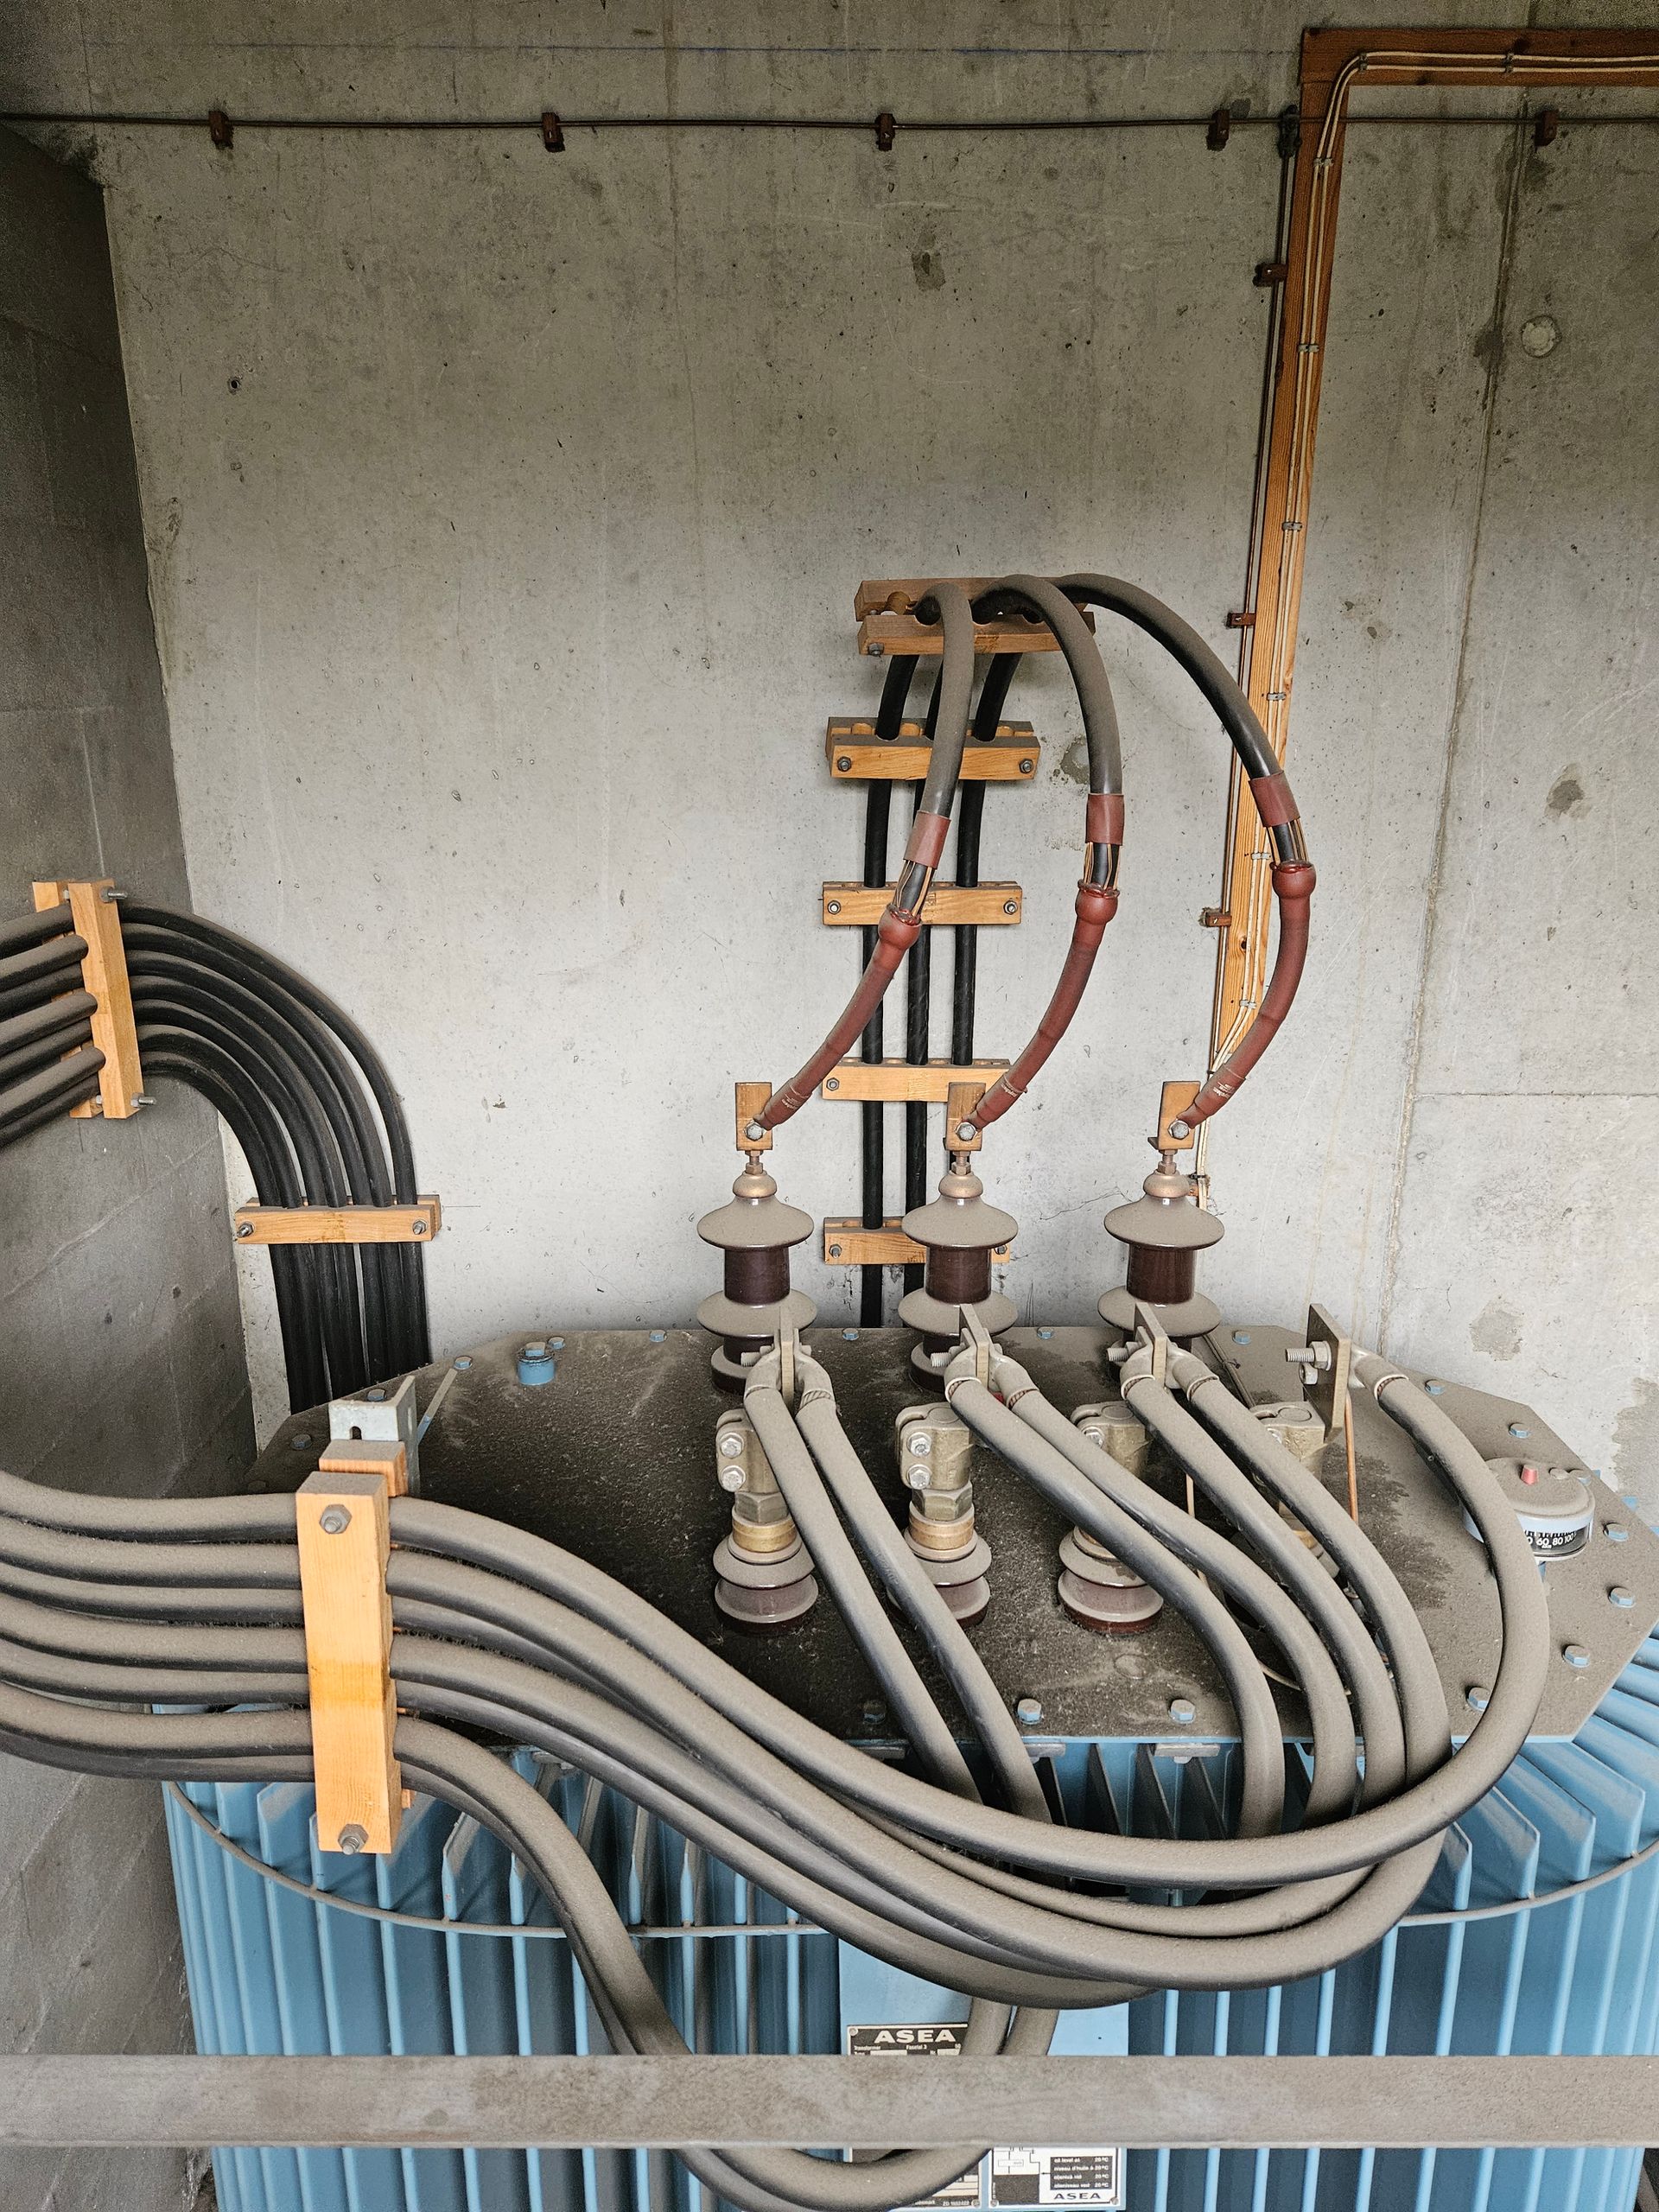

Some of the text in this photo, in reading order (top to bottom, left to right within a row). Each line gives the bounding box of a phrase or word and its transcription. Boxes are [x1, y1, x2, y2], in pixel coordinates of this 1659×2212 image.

[1536, 1537, 1549, 1546] 60
[1552, 1537, 1563, 1546] 80
[1565, 1533, 1573, 1543] 100
[874, 2029, 956, 2044] ASEA
